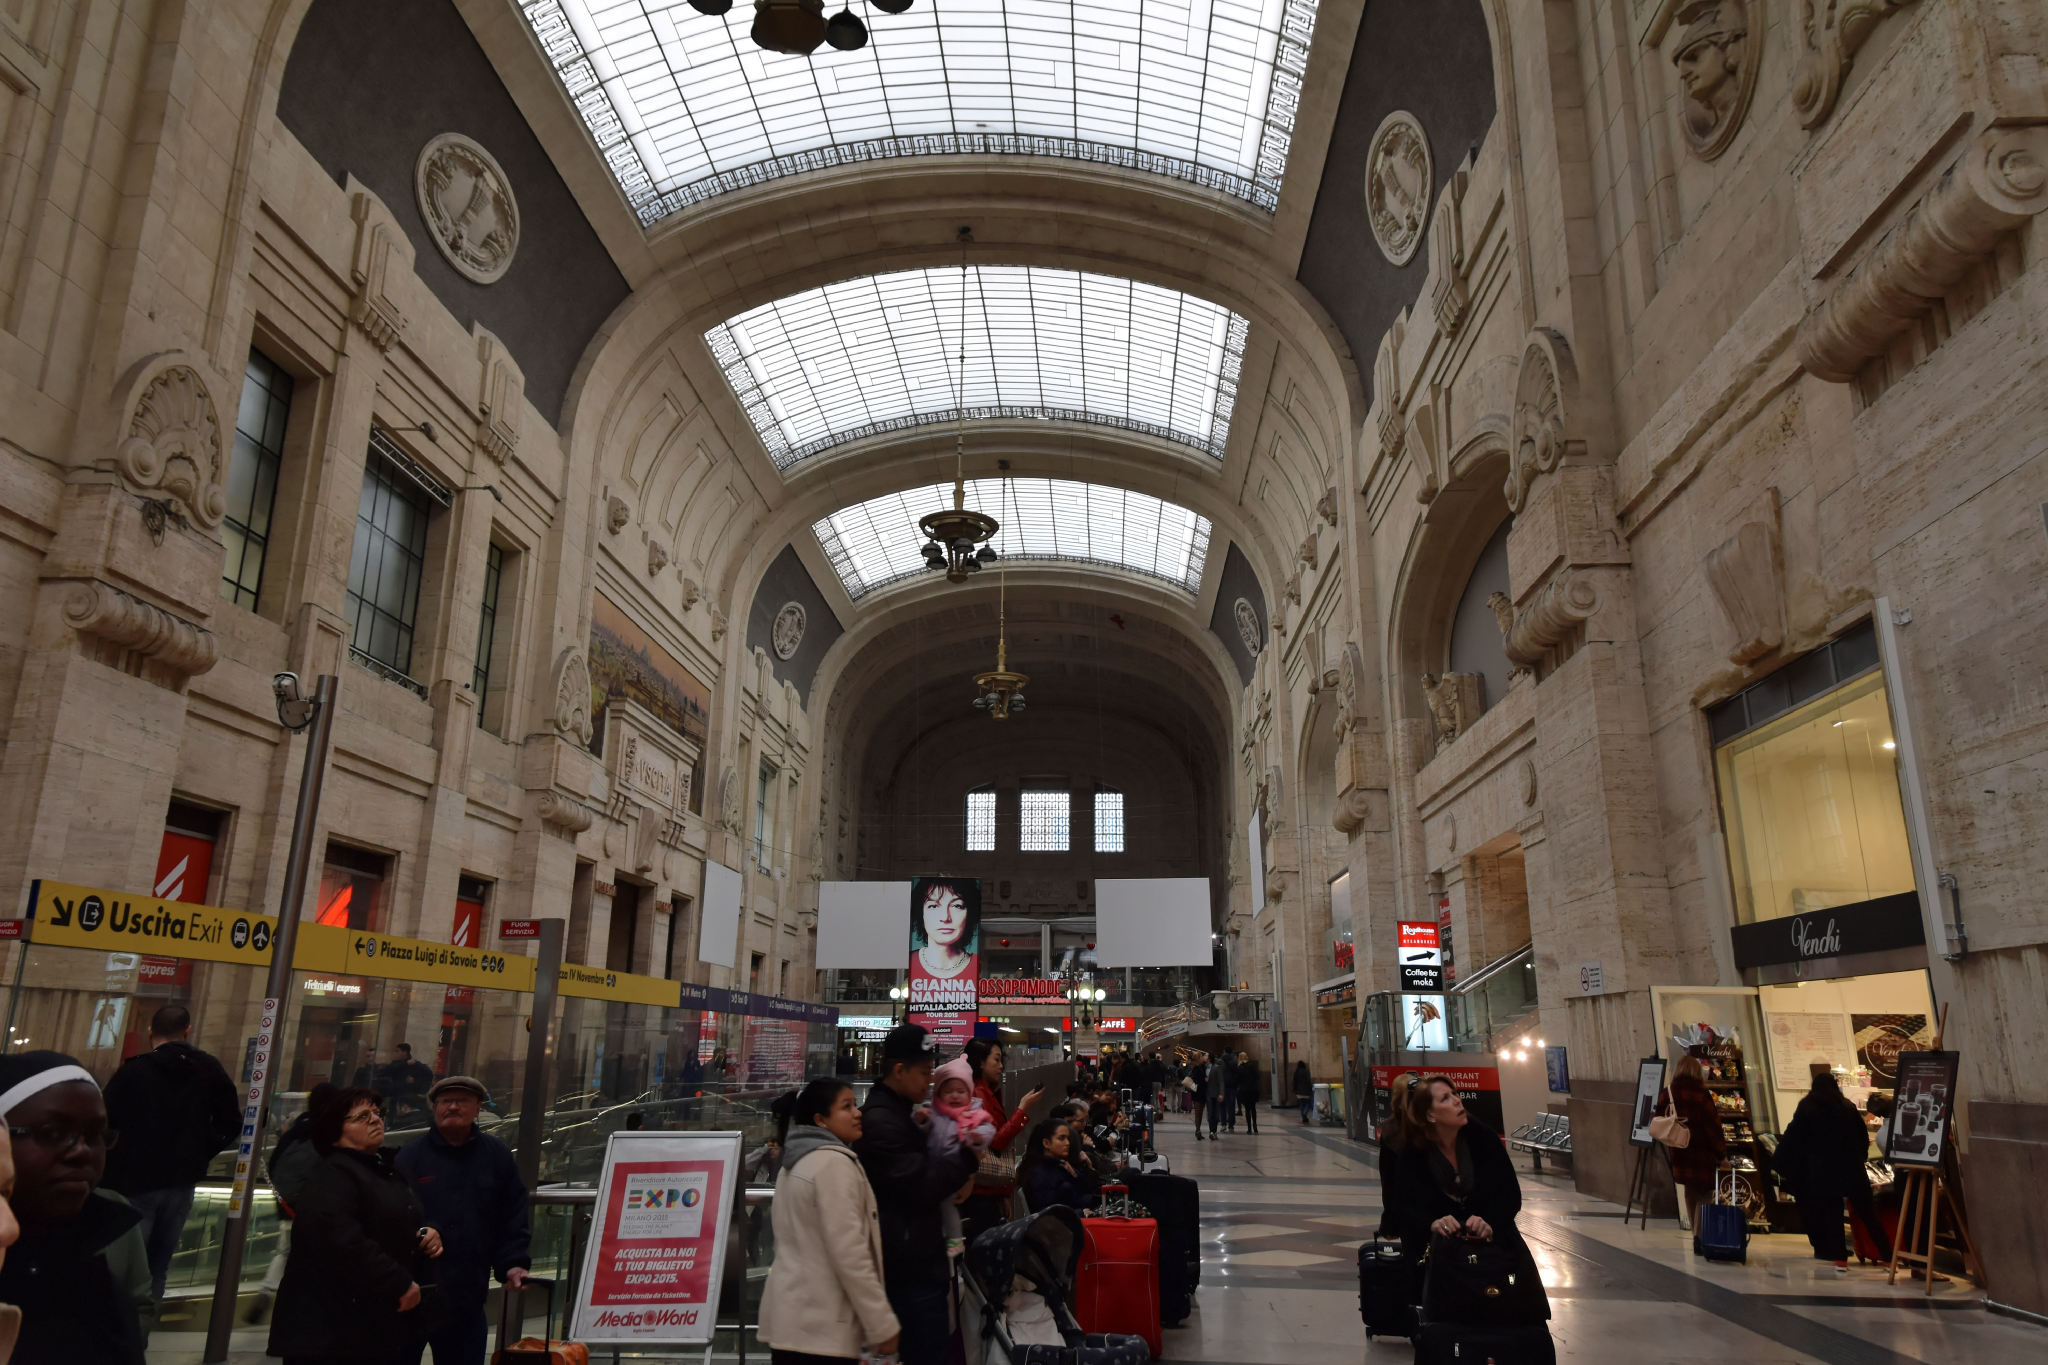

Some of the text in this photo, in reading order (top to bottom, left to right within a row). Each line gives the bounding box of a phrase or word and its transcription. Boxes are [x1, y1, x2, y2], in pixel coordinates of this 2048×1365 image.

[110, 901, 224, 944] Uscita Exit
[1402, 924, 1435, 936] Roadhouse
[1791, 917, 1841, 957] Venchi
[380, 941, 478, 968] Piazza Luigi di Savoia
[140, 964, 176, 978] express
[569, 968, 576, 981] IV
[576, 969, 605, 985] Novembre
[1405, 968, 1429, 977] Coffee
[1428, 969, 1438, 977] Bar
[911, 978, 977, 992] GIANNA
[911, 991, 976, 1003] NANNINI
[909, 1003, 977, 1012] HITALIA.ROCKS
[1701, 1045, 1732, 1057] Venchi
[1872, 1041, 1906, 1057] Venc
[1459, 1091, 1477, 1099] BAR
[627, 1188, 701, 1209] EXPO
[614, 1247, 698, 1260] ACQUISTA DA NOI
[614, 1260, 694, 1271] IL TUO BIGLIETTO
[625, 1273, 679, 1284] EXPO 2015.
[593, 1309, 699, 1328] Media World
